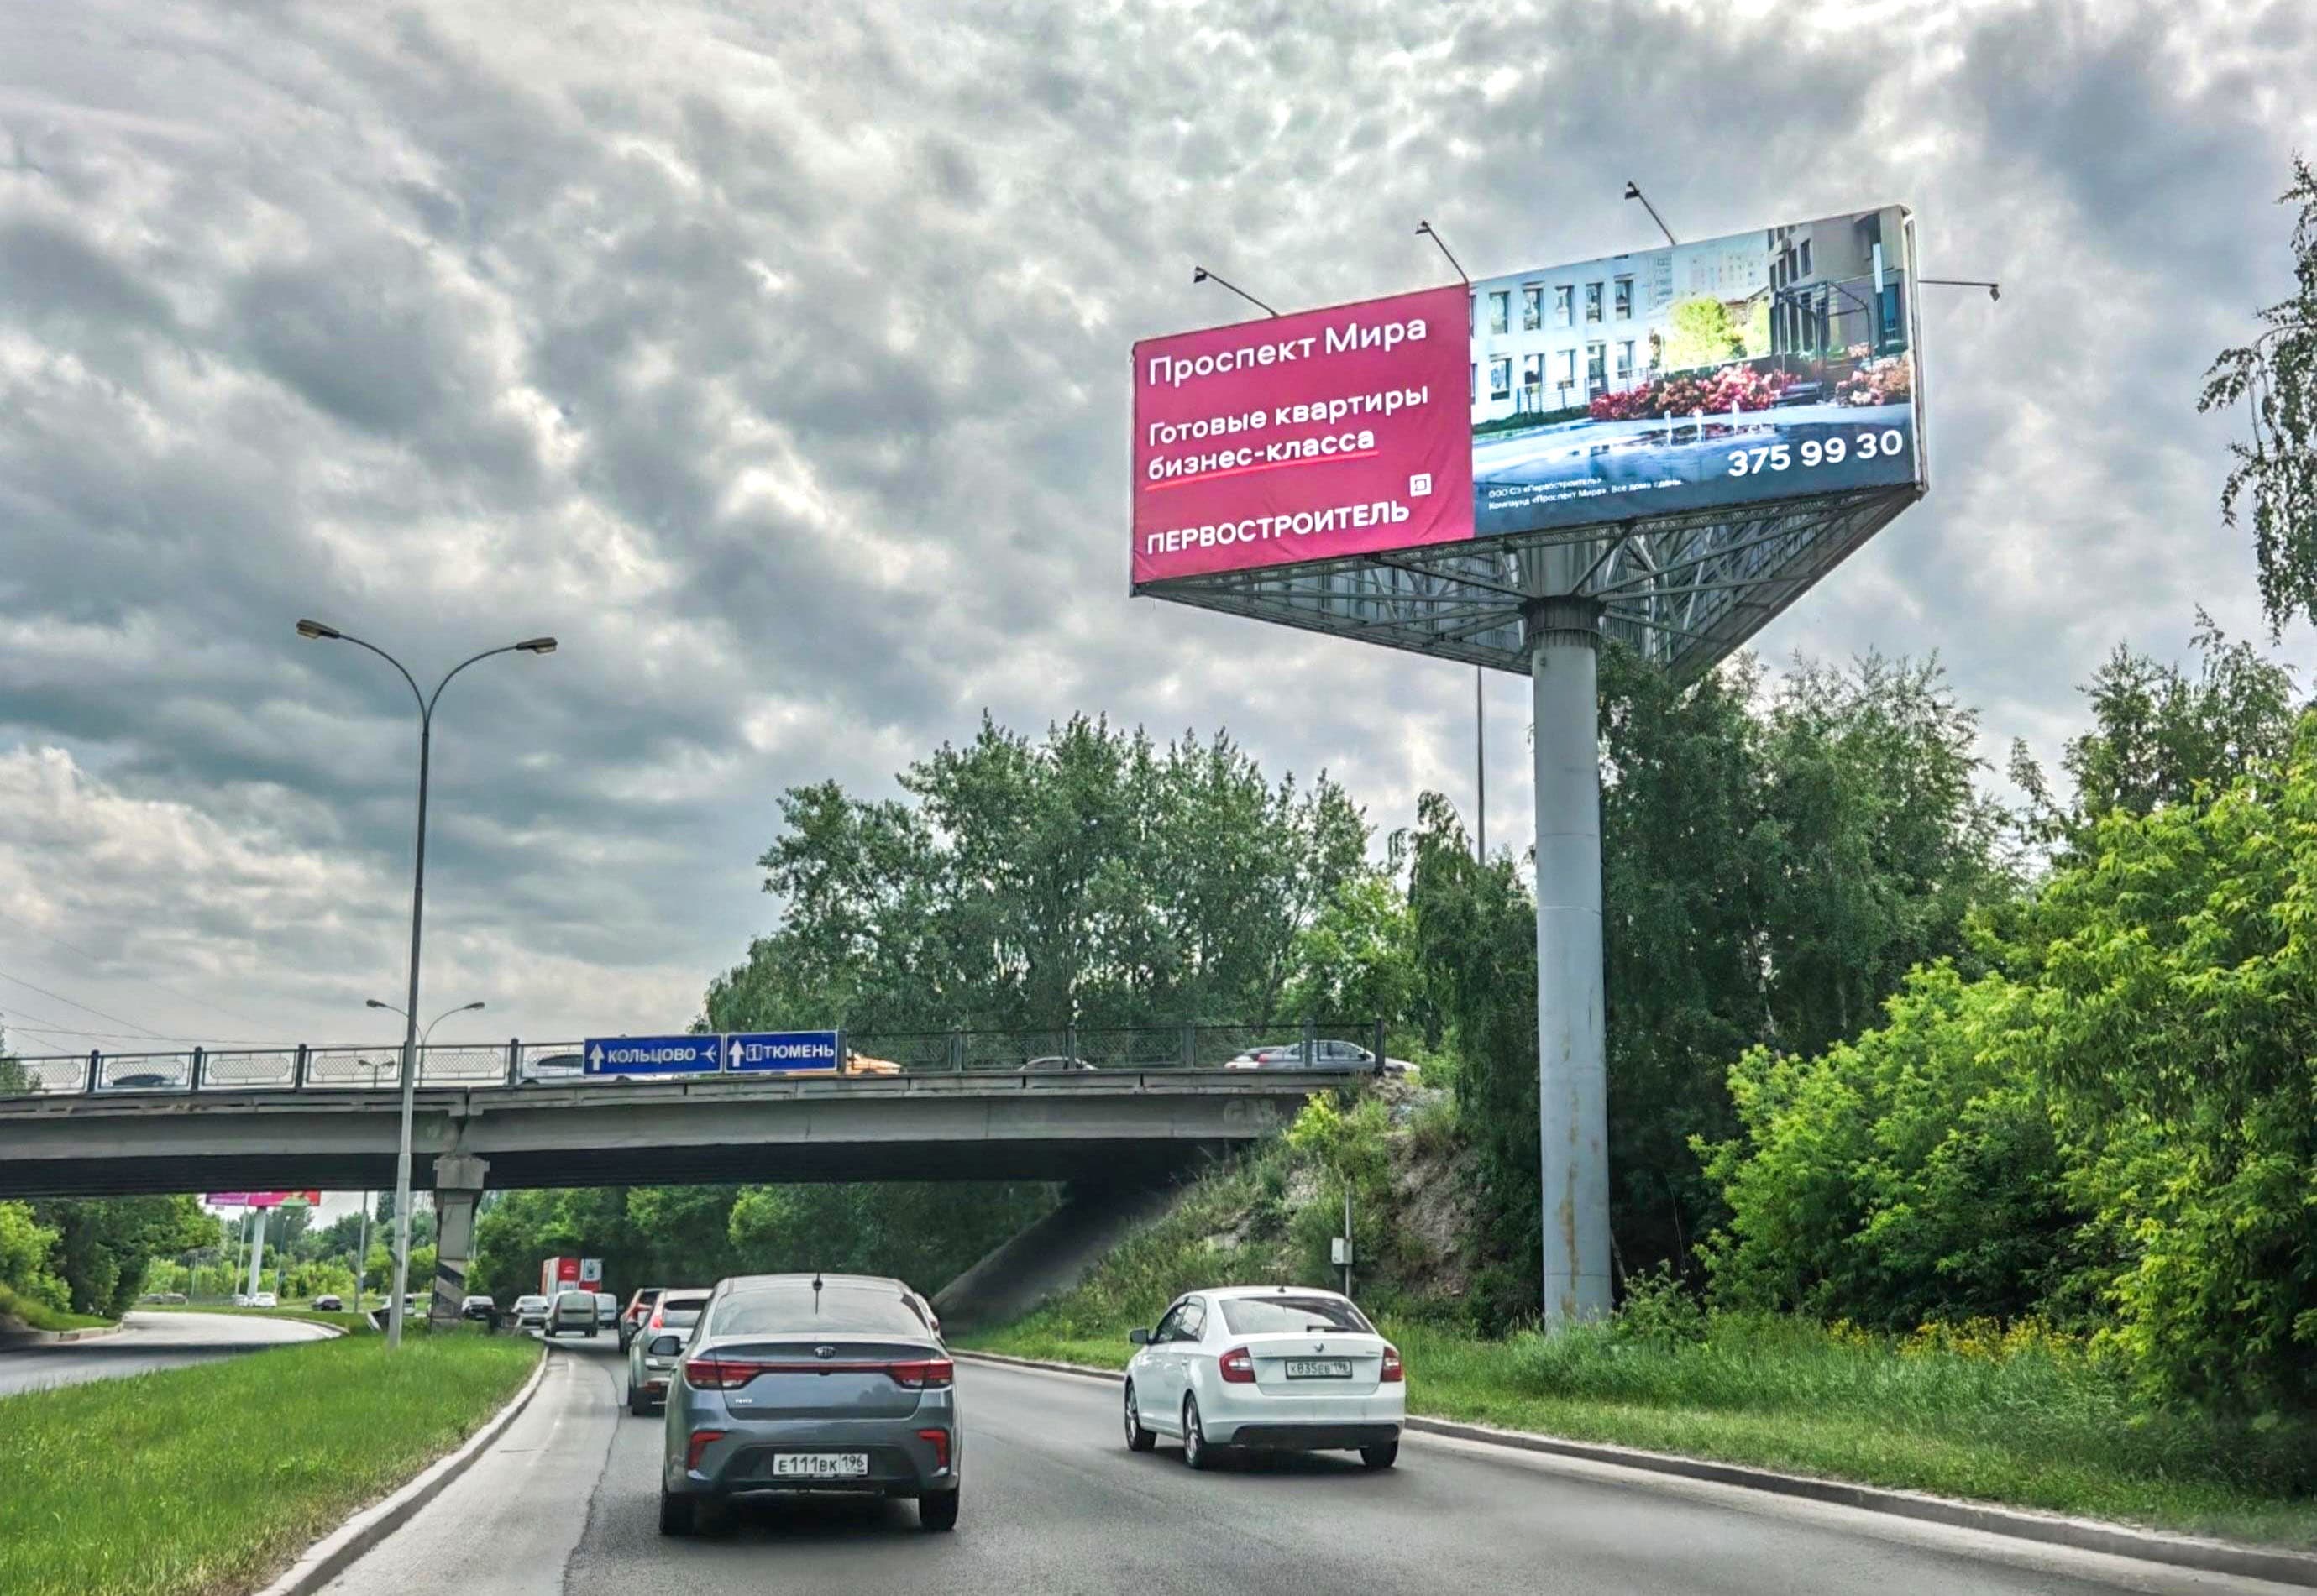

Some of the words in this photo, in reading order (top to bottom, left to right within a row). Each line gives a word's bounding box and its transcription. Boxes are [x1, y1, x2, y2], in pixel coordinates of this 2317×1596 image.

[1150, 338, 1316, 387] Проспект
[1325, 319, 1427, 353] Мира
[1150, 411, 1267, 447] Готовые
[1276, 385, 1428, 425] квартиры
[1148, 430, 1375, 480] бизнес-класса
[1727, 444, 1791, 477] 375
[1801, 437, 1847, 467] 99
[1856, 429, 1903, 459] 30
[1488, 489, 1508, 499] ООО
[1611, 484, 1627, 494] Все
[1147, 500, 1410, 554] ПЕРВОСТРОИТЕЛЬ
[607, 1048, 696, 1065] КОЛЬЦОВО
[763, 1044, 835, 1059] ТЮМЕНЬ
[778, 1456, 838, 1473] Е111ВК
[841, 1454, 865, 1468] 196
